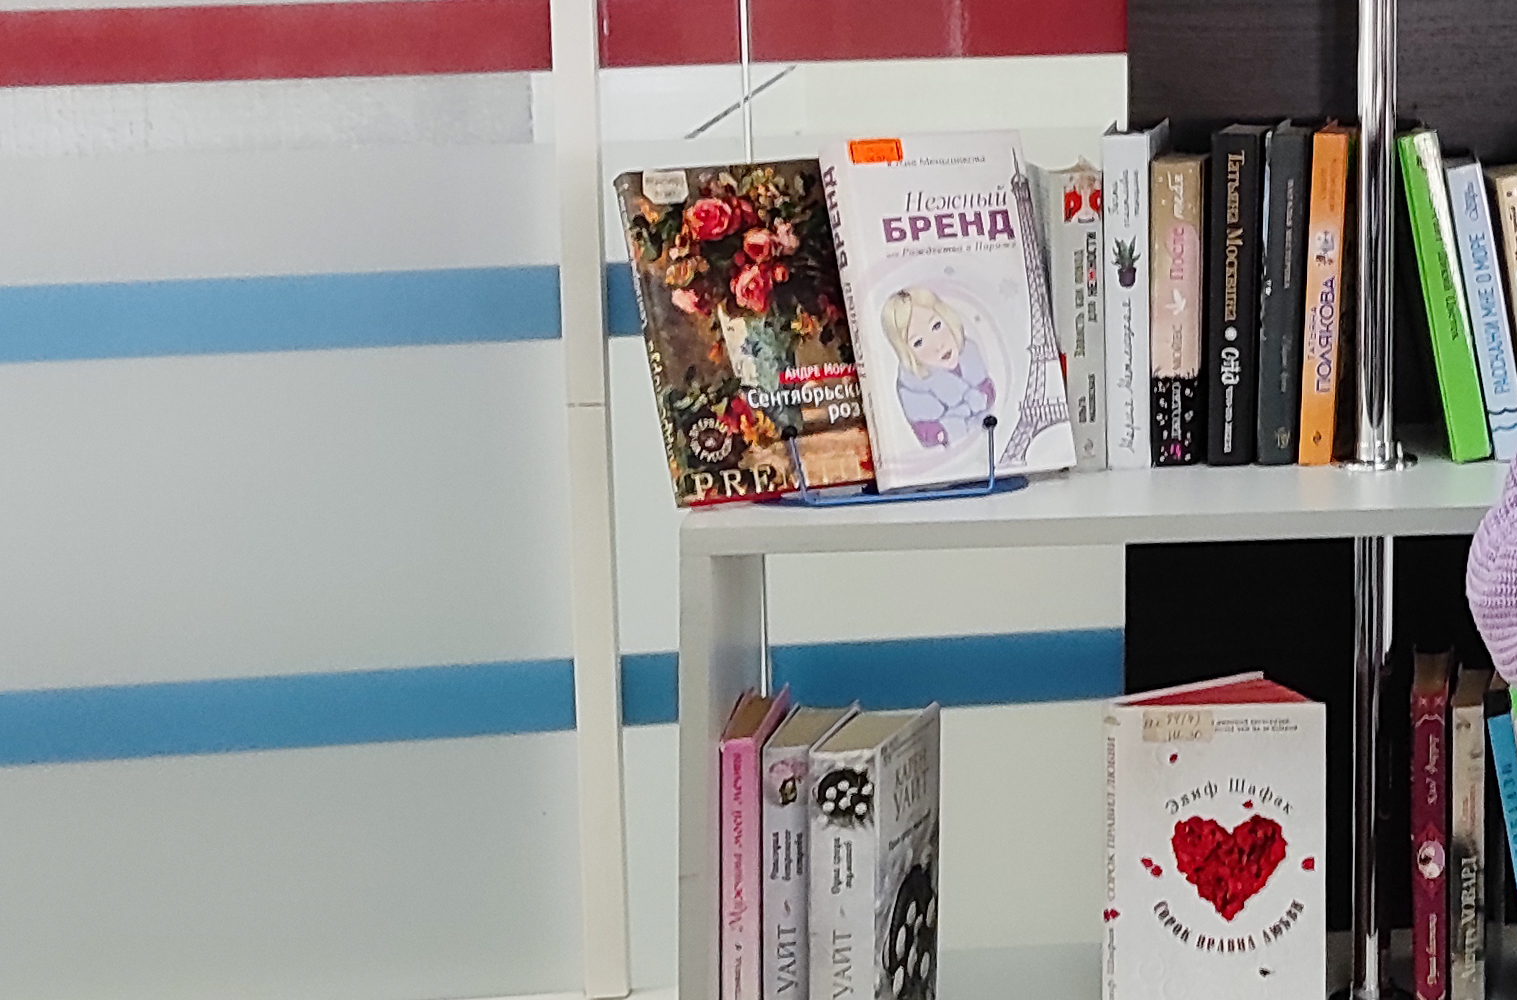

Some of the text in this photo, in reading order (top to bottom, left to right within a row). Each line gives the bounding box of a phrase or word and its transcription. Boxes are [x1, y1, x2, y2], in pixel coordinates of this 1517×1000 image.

[905, 184, 1008, 213] Нежный
[822, 165, 850, 270] БРЕНД
[882, 208, 1016, 244] БРЕНД
[1315, 275, 1336, 394] ПОЛЯКОВА
[784, 363, 821, 382] АНДРЕ
[1165, 777, 1294, 816] Элиф Шафак
